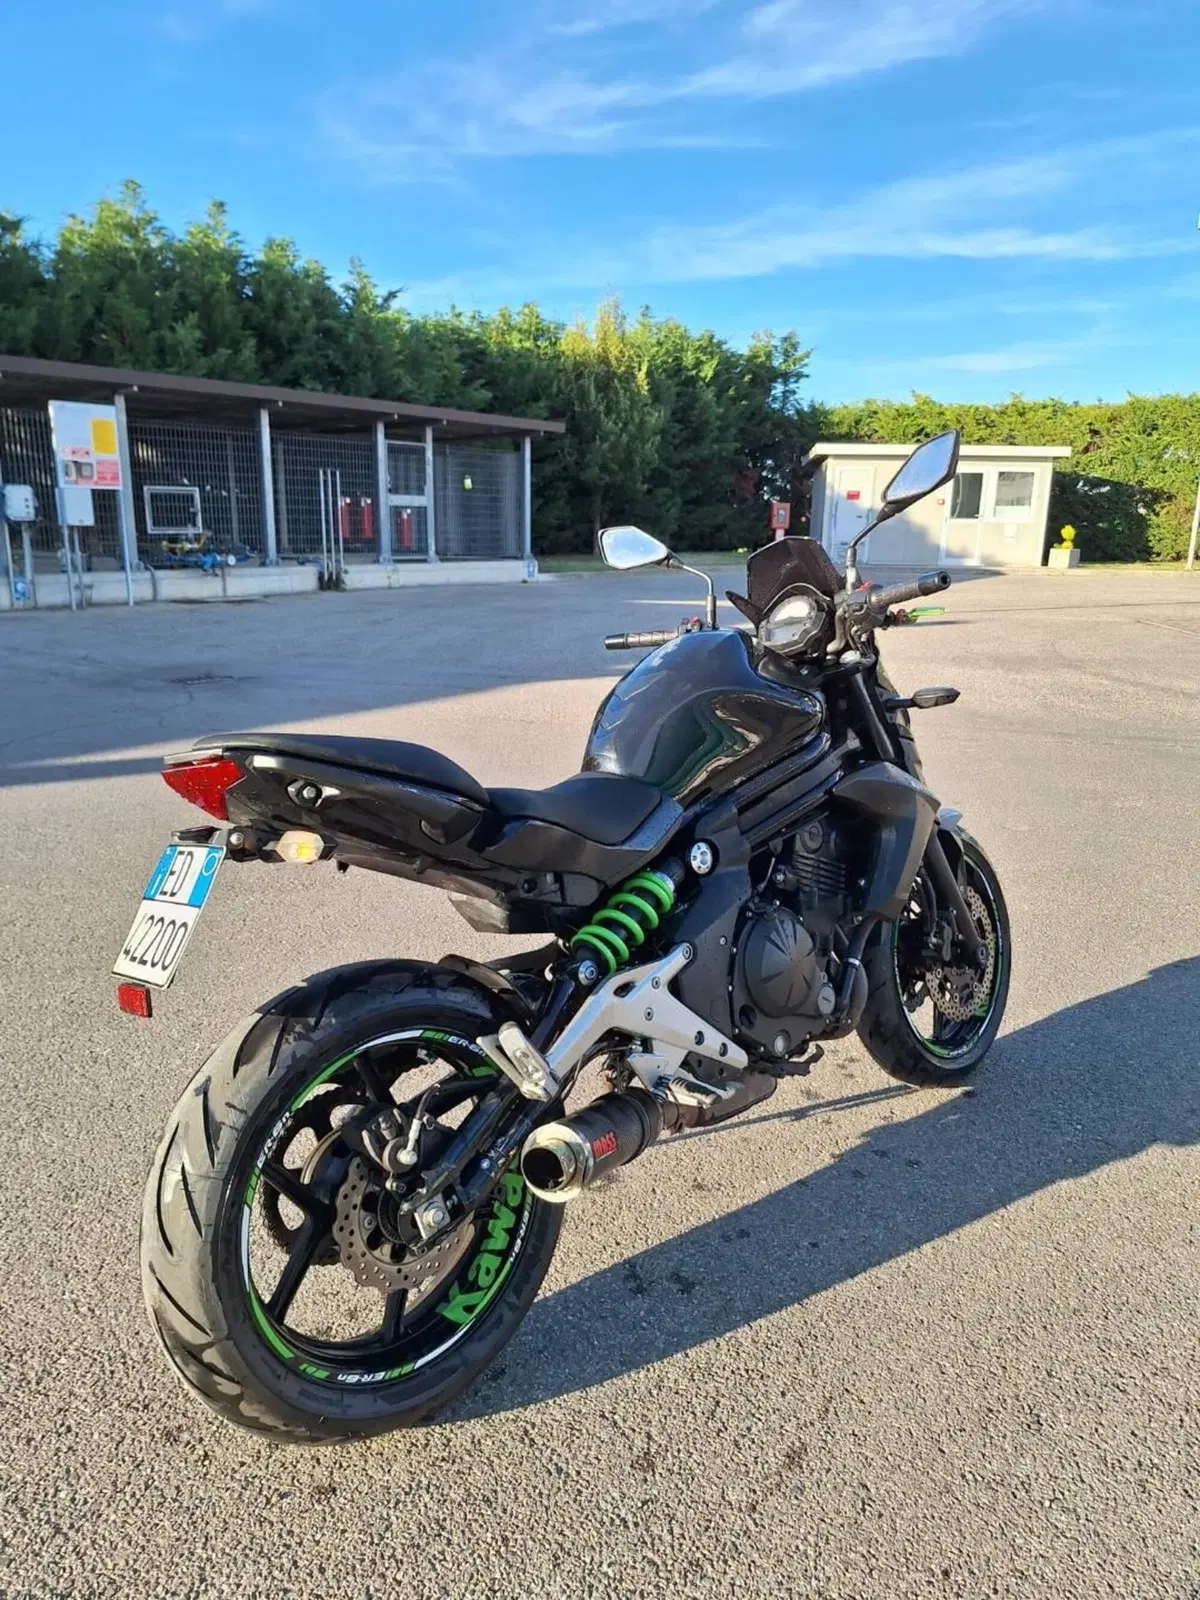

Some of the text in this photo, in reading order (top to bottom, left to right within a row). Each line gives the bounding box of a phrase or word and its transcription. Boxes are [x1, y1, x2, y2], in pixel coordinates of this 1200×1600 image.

[159, 850, 194, 898] ED
[123, 913, 188, 971] 42200
[592, 1131, 618, 1159] MASS
[435, 1172, 524, 1325] Kawa
